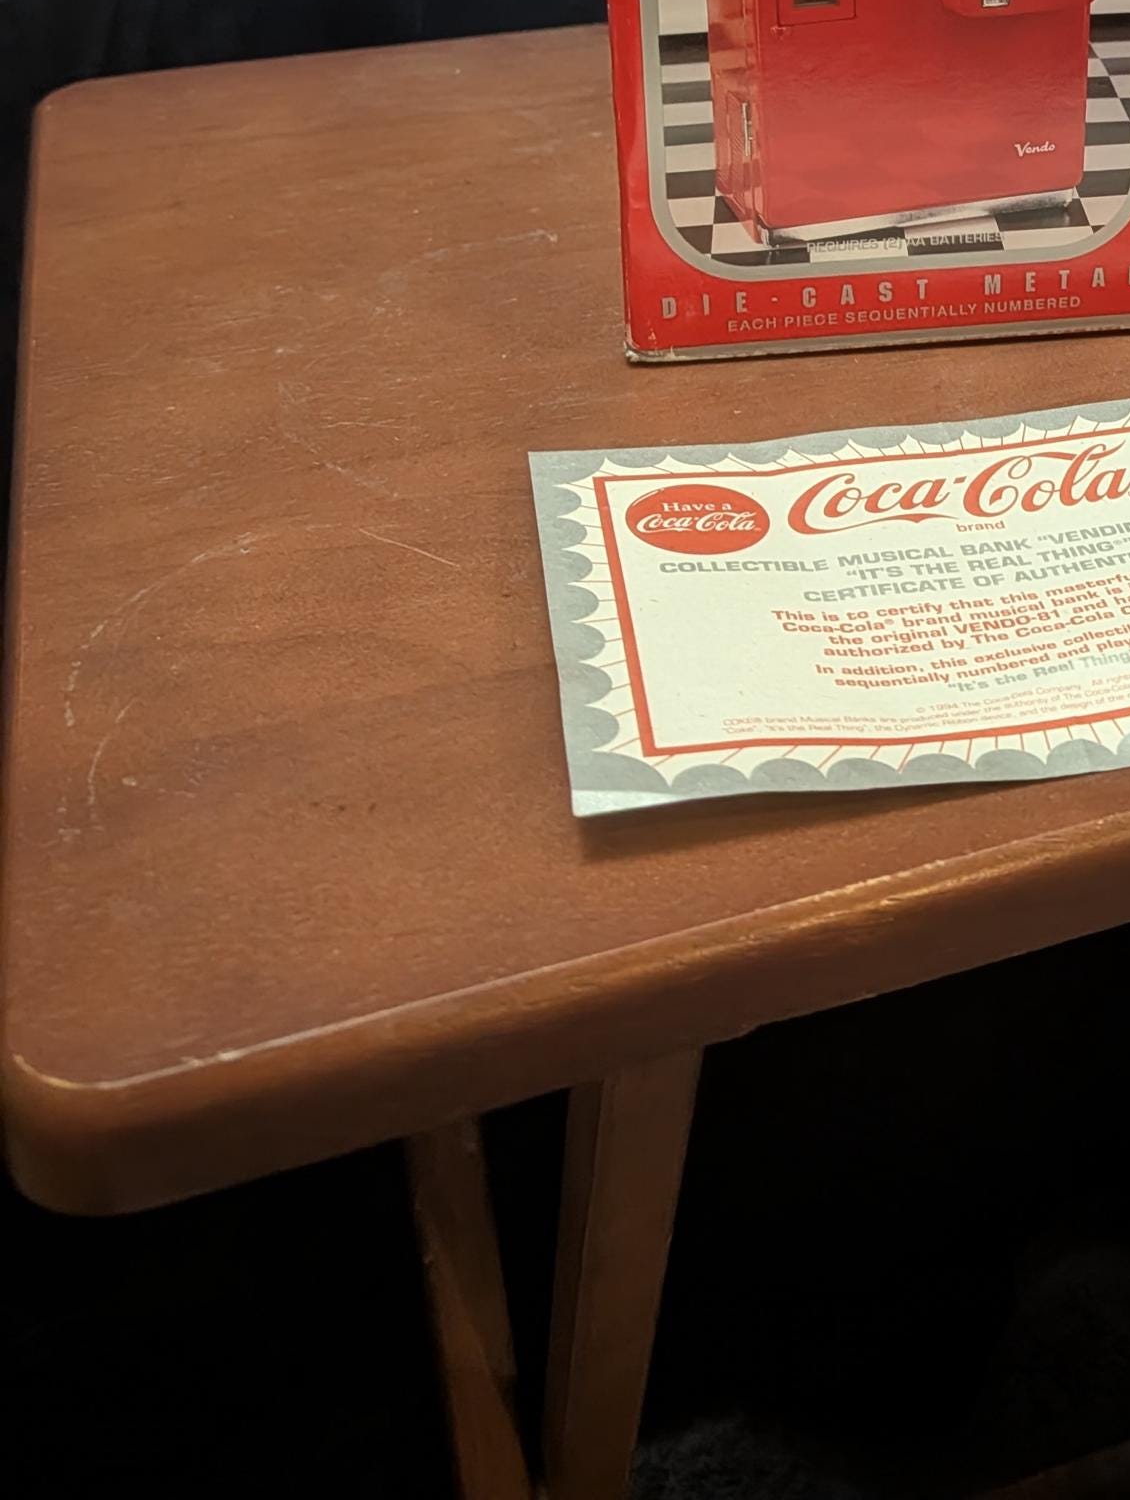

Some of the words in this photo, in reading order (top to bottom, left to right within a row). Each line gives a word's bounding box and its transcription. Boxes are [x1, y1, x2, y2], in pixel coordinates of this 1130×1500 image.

[1015, 141, 1056, 157] Vendo
[807, 239, 878, 253] REQUIRES
[883, 237, 902, 250] (2)
[906, 235, 925, 246] AA
[930, 232, 1001, 245] BATTERIES
[728, 318, 777, 332] EACH
[784, 313, 838, 327] PIECE
[844, 303, 978, 323] SEQUENTIALLY
[984, 296, 1081, 314] NUMBERED
[663, 502, 716, 512] Have
[722, 503, 732, 511] a
[636, 512, 757, 532] Coca-Cola
[956, 521, 1005, 533] brand
[660, 560, 829, 573] COLLECTIBLE
[838, 546, 954, 567] MUSICAL
[960, 538, 1031, 556] BANK
[910, 562, 960, 576] THE
[968, 554, 1032, 573] REAL
[804, 578, 964, 602] CERTIFICATE
[973, 574, 1005, 587] OF
[771, 610, 815, 621] This
[823, 611, 839, 621] is
[847, 610, 869, 620] to
[876, 603, 942, 618] certify
[949, 598, 994, 609] that
[1002, 590, 1038, 605] this
[902, 613, 962, 627] brand
[969, 601, 1044, 620] musical
[1052, 591, 1100, 606] bank
[1106, 587, 1122, 596] is
[824, 641, 934, 657] authorized
[940, 639, 964, 649] by
[971, 632, 1009, 644] The
[1015, 610, 1114, 638] Coca-Cola
[829, 636, 864, 645] the
[871, 626, 947, 643] original
[953, 610, 1060, 634] VENDO-81
[1072, 600, 1107, 614] and
[816, 664, 834, 674] In
[842, 664, 924, 676] addition,
[930, 658, 967, 669] this
[974, 642, 1057, 663] exclusive
[835, 672, 949, 689] sequentially
[957, 653, 1050, 680] numbered
[1058, 644, 1090, 659] and
[995, 673, 1028, 686] the
[1032, 660, 1075, 678] Real
